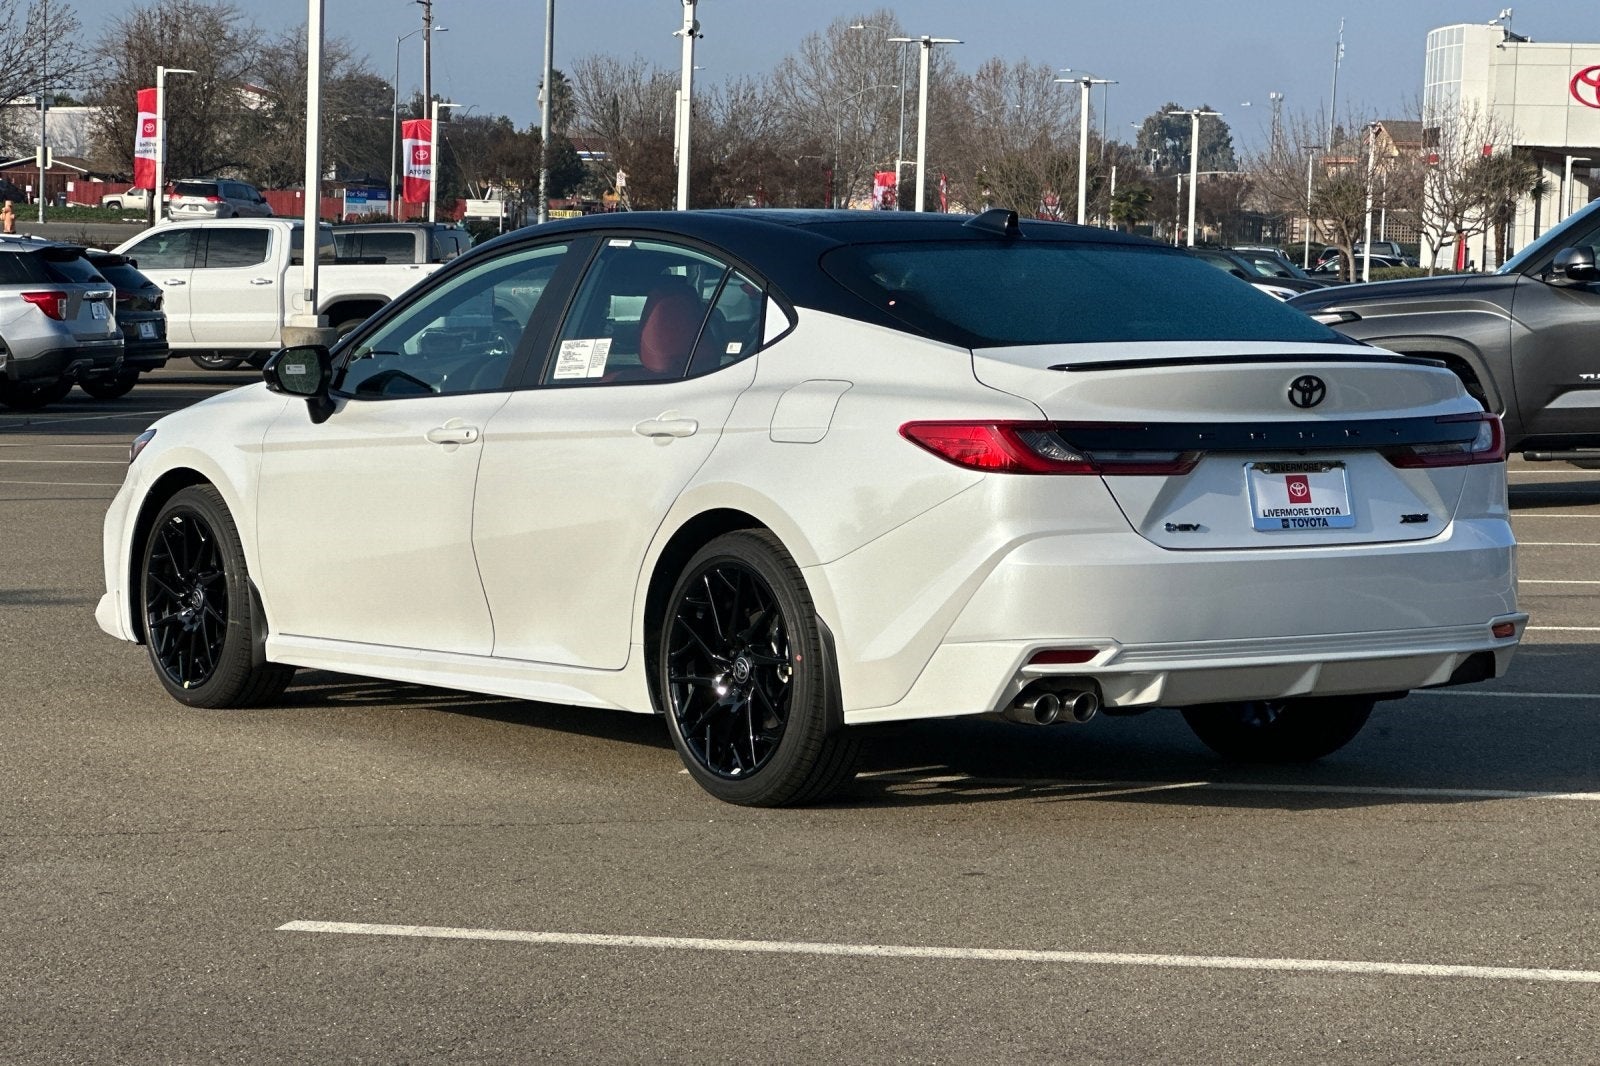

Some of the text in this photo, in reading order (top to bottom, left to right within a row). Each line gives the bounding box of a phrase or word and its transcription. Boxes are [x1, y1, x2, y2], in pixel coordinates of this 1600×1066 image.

[1274, 463, 1319, 472] LIVERMORE
[1263, 507, 1341, 517] LIVERMORE TOYOTA
[1291, 518, 1329, 528] TOYOTA
